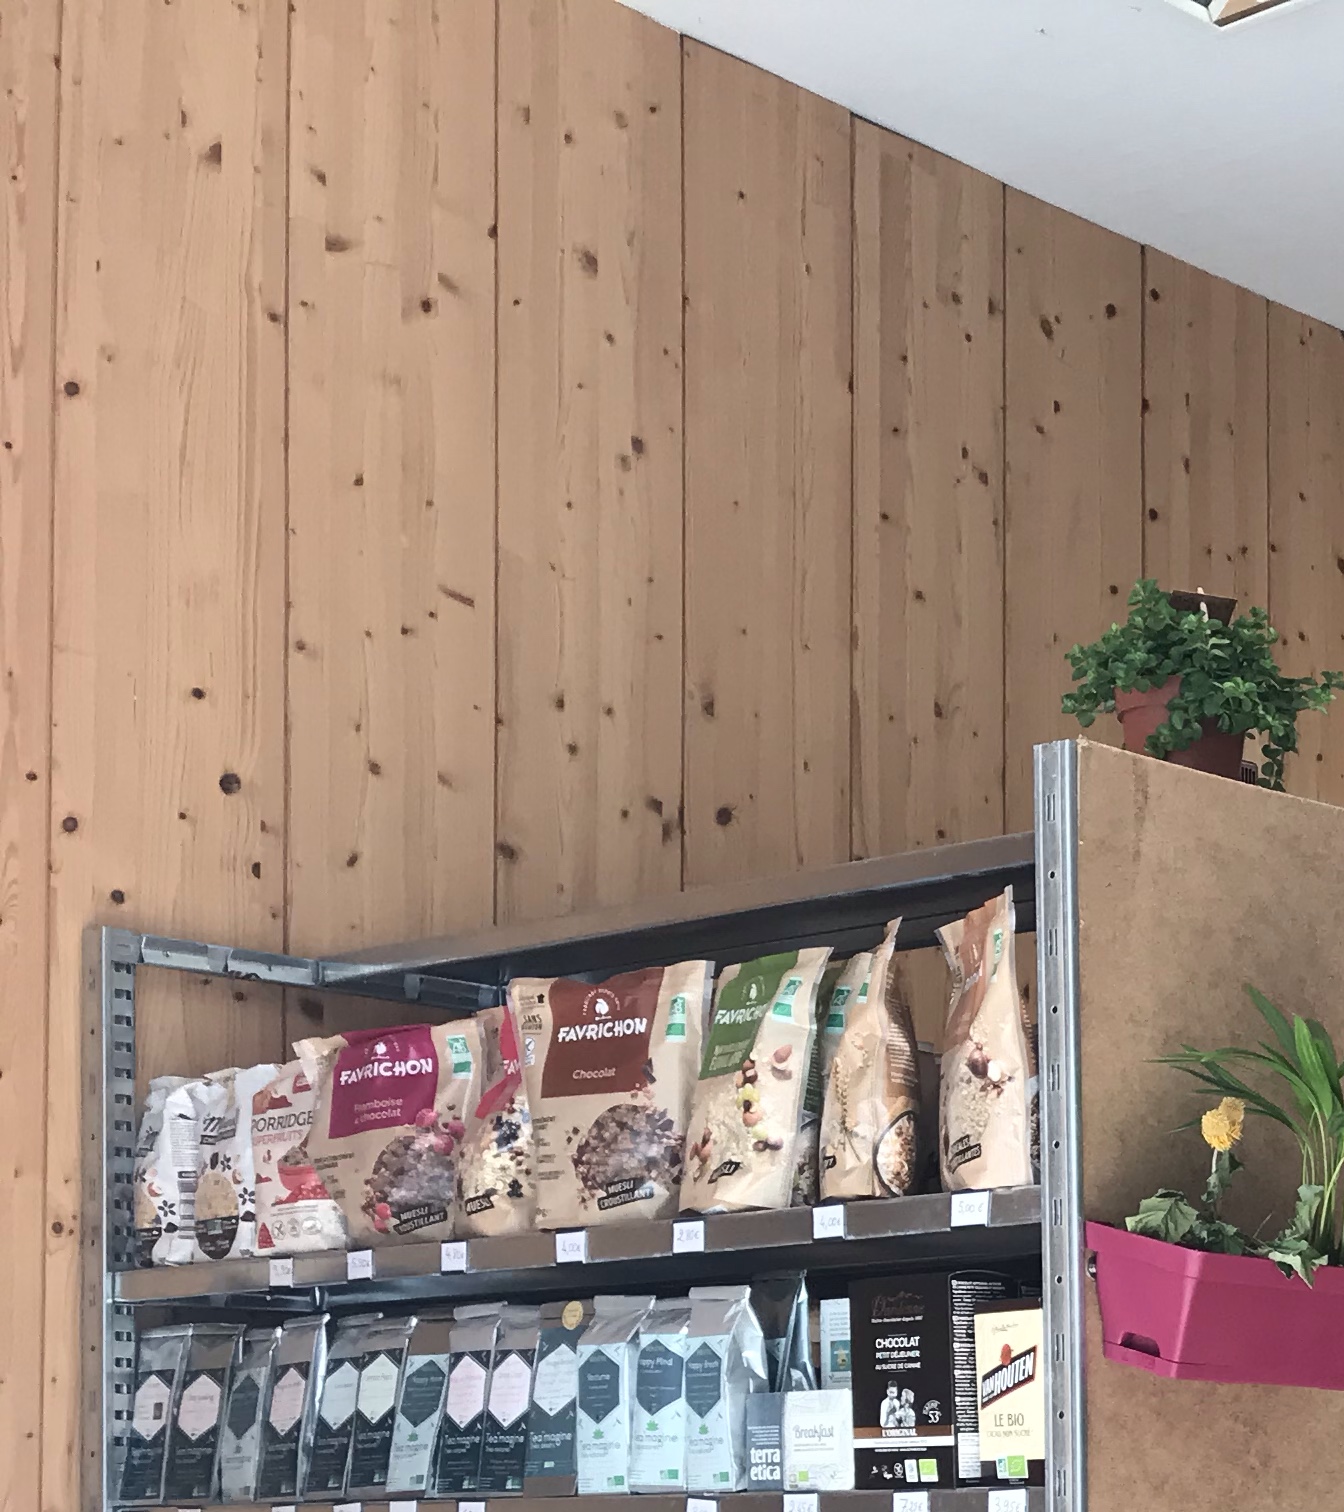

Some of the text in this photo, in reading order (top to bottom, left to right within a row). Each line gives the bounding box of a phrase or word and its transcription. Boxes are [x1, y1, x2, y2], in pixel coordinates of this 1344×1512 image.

[557, 1016, 648, 1044] FAVRICHON
[339, 1056, 434, 1087] FAVRICHON
[572, 1066, 617, 1081] Chocolat
[607, 1179, 635, 1195] MUESLI
[875, 1335, 921, 1349] CHOCOLAT
[993, 1351, 1034, 1396] HOUTEN
[993, 1412, 1025, 1427] LE BIO
[792, 1423, 835, 1442] Breakfast
[749, 1447, 781, 1464] terra
[749, 1464, 781, 1482] etica
